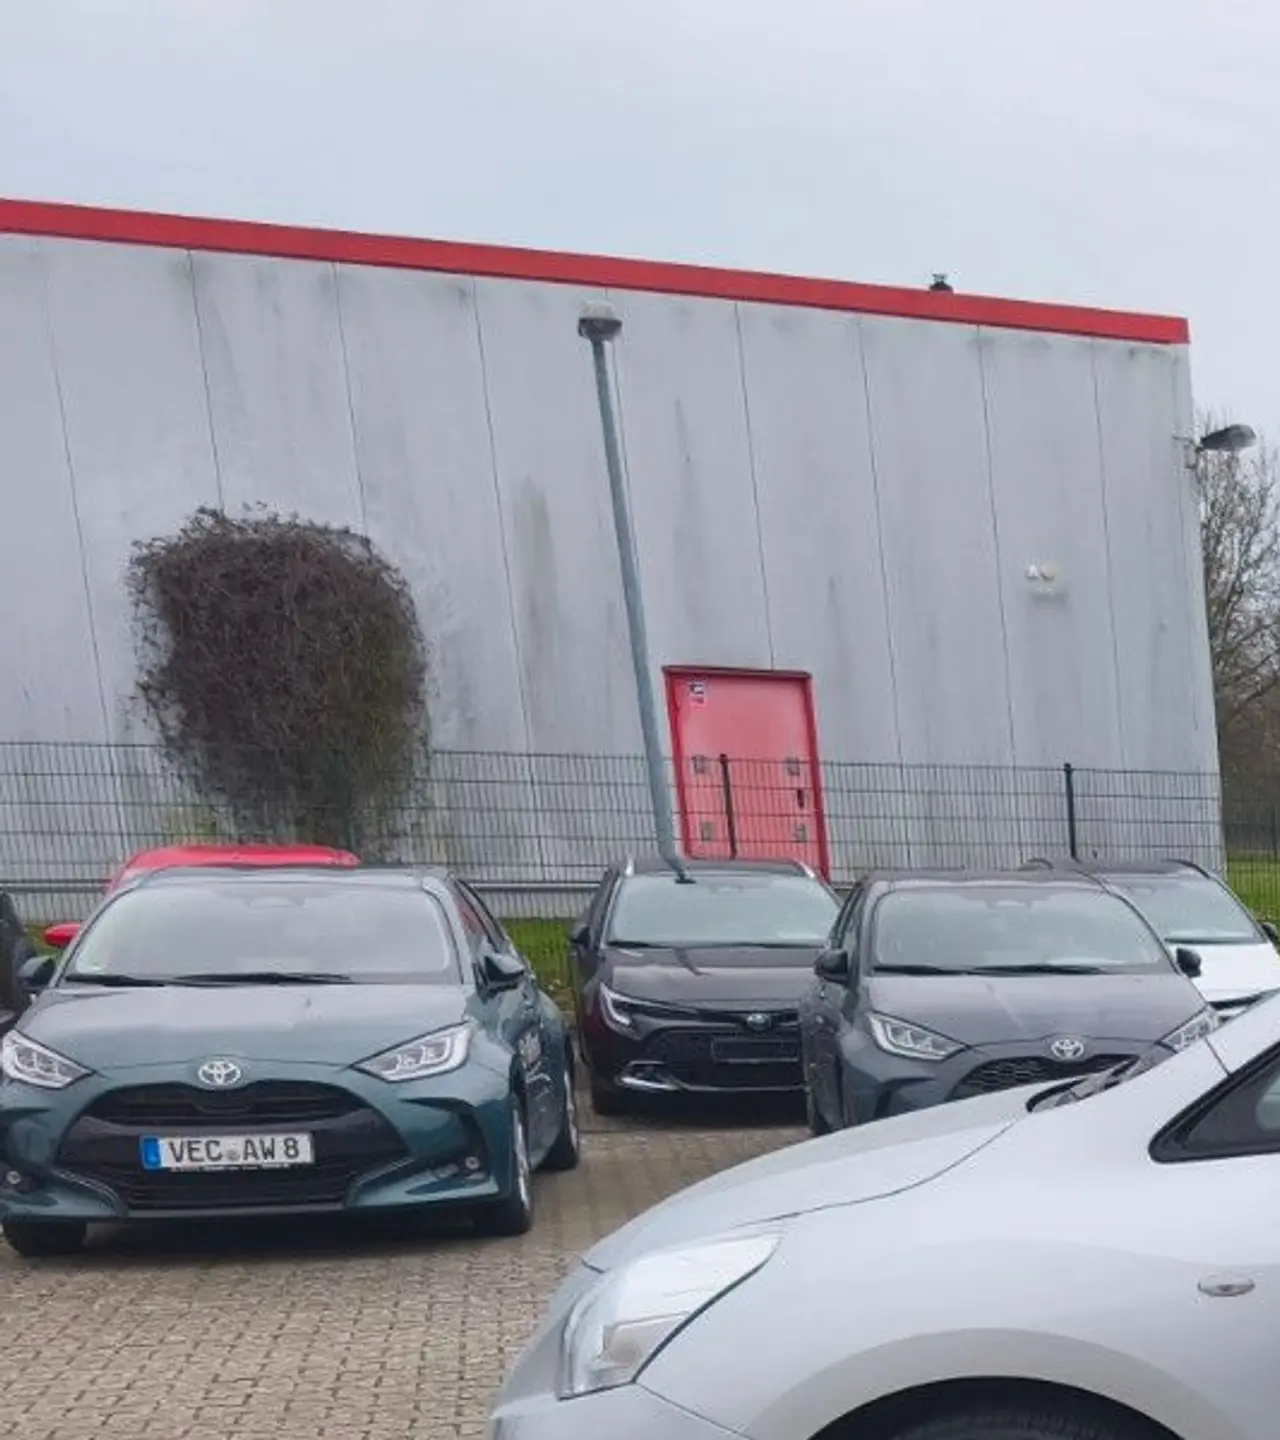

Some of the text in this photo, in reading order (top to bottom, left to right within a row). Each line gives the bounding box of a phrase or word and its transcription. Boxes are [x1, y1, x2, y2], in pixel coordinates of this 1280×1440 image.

[168, 1136, 300, 1163] VEC AW 8
